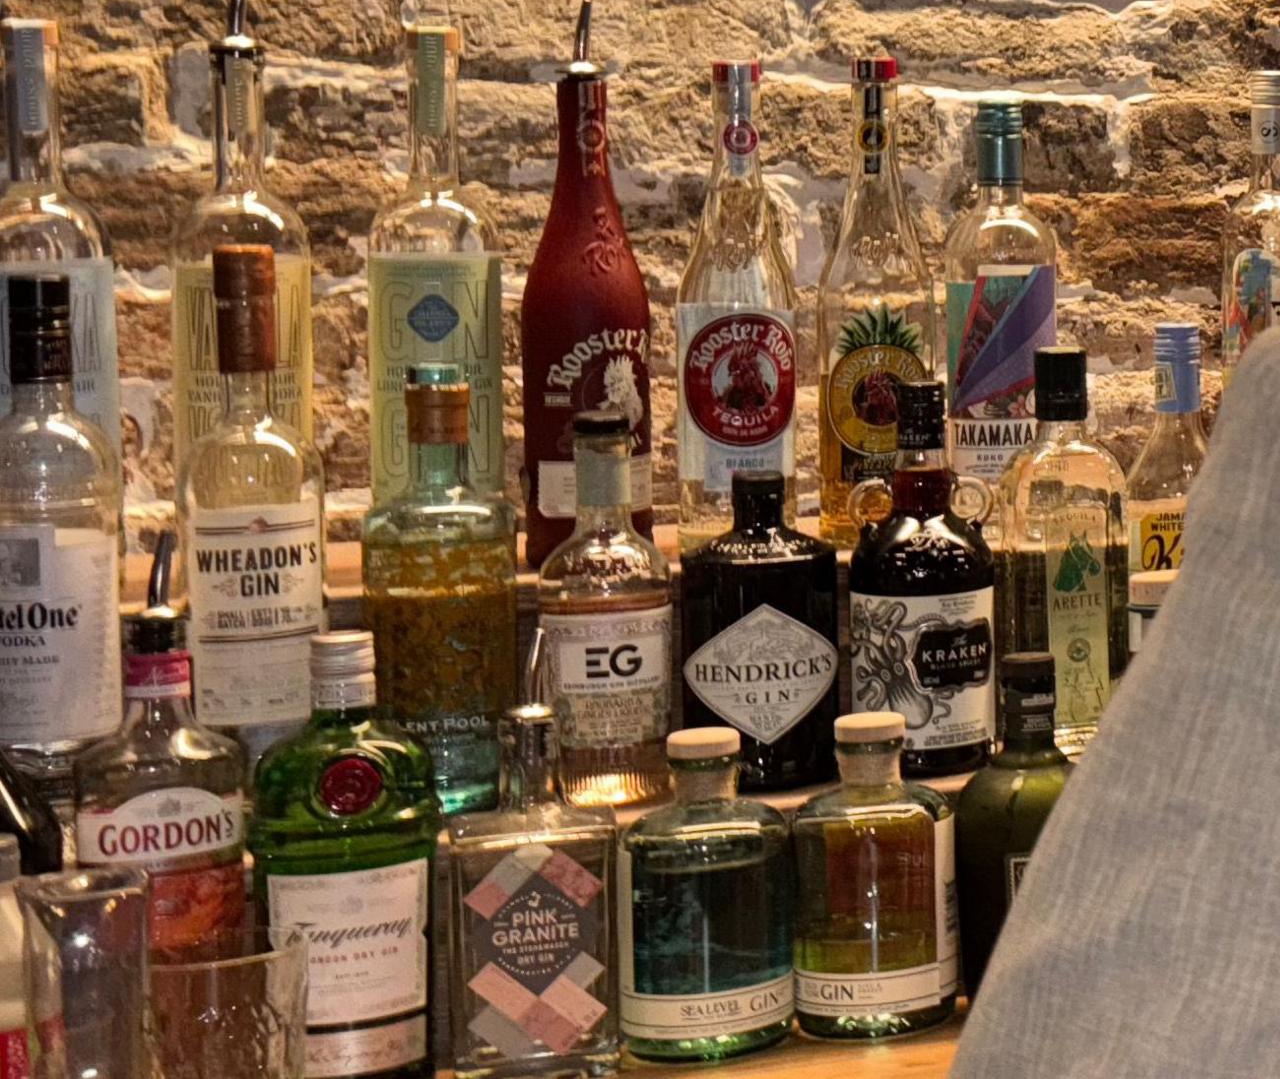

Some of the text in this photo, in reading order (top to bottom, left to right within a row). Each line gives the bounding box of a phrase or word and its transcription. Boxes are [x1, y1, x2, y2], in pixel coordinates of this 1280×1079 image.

[689, 320, 765, 371] Rooster
[546, 327, 639, 390] Rooster
[711, 404, 780, 427] TEQUILA
[954, 422, 1034, 447] TAKAMAKA
[195, 541, 318, 573] WHEADON'S
[240, 573, 280, 598] GIN
[1052, 592, 1101, 613] ARETTE
[0, 602, 79, 631] tel One
[585, 643, 642, 679] EG
[922, 642, 988, 664] KRAKEN
[695, 653, 832, 683] HENDRICK'S
[745, 688, 791, 705] GIN
[443, 714, 490, 731] POOL
[98, 809, 234, 857] GORDON'S
[512, 906, 558, 928] PINK
[492, 922, 580, 947] GRANITE
[309, 954, 348, 965] ONDON
[750, 992, 779, 1012] GIN
[820, 983, 854, 1001] GIN
